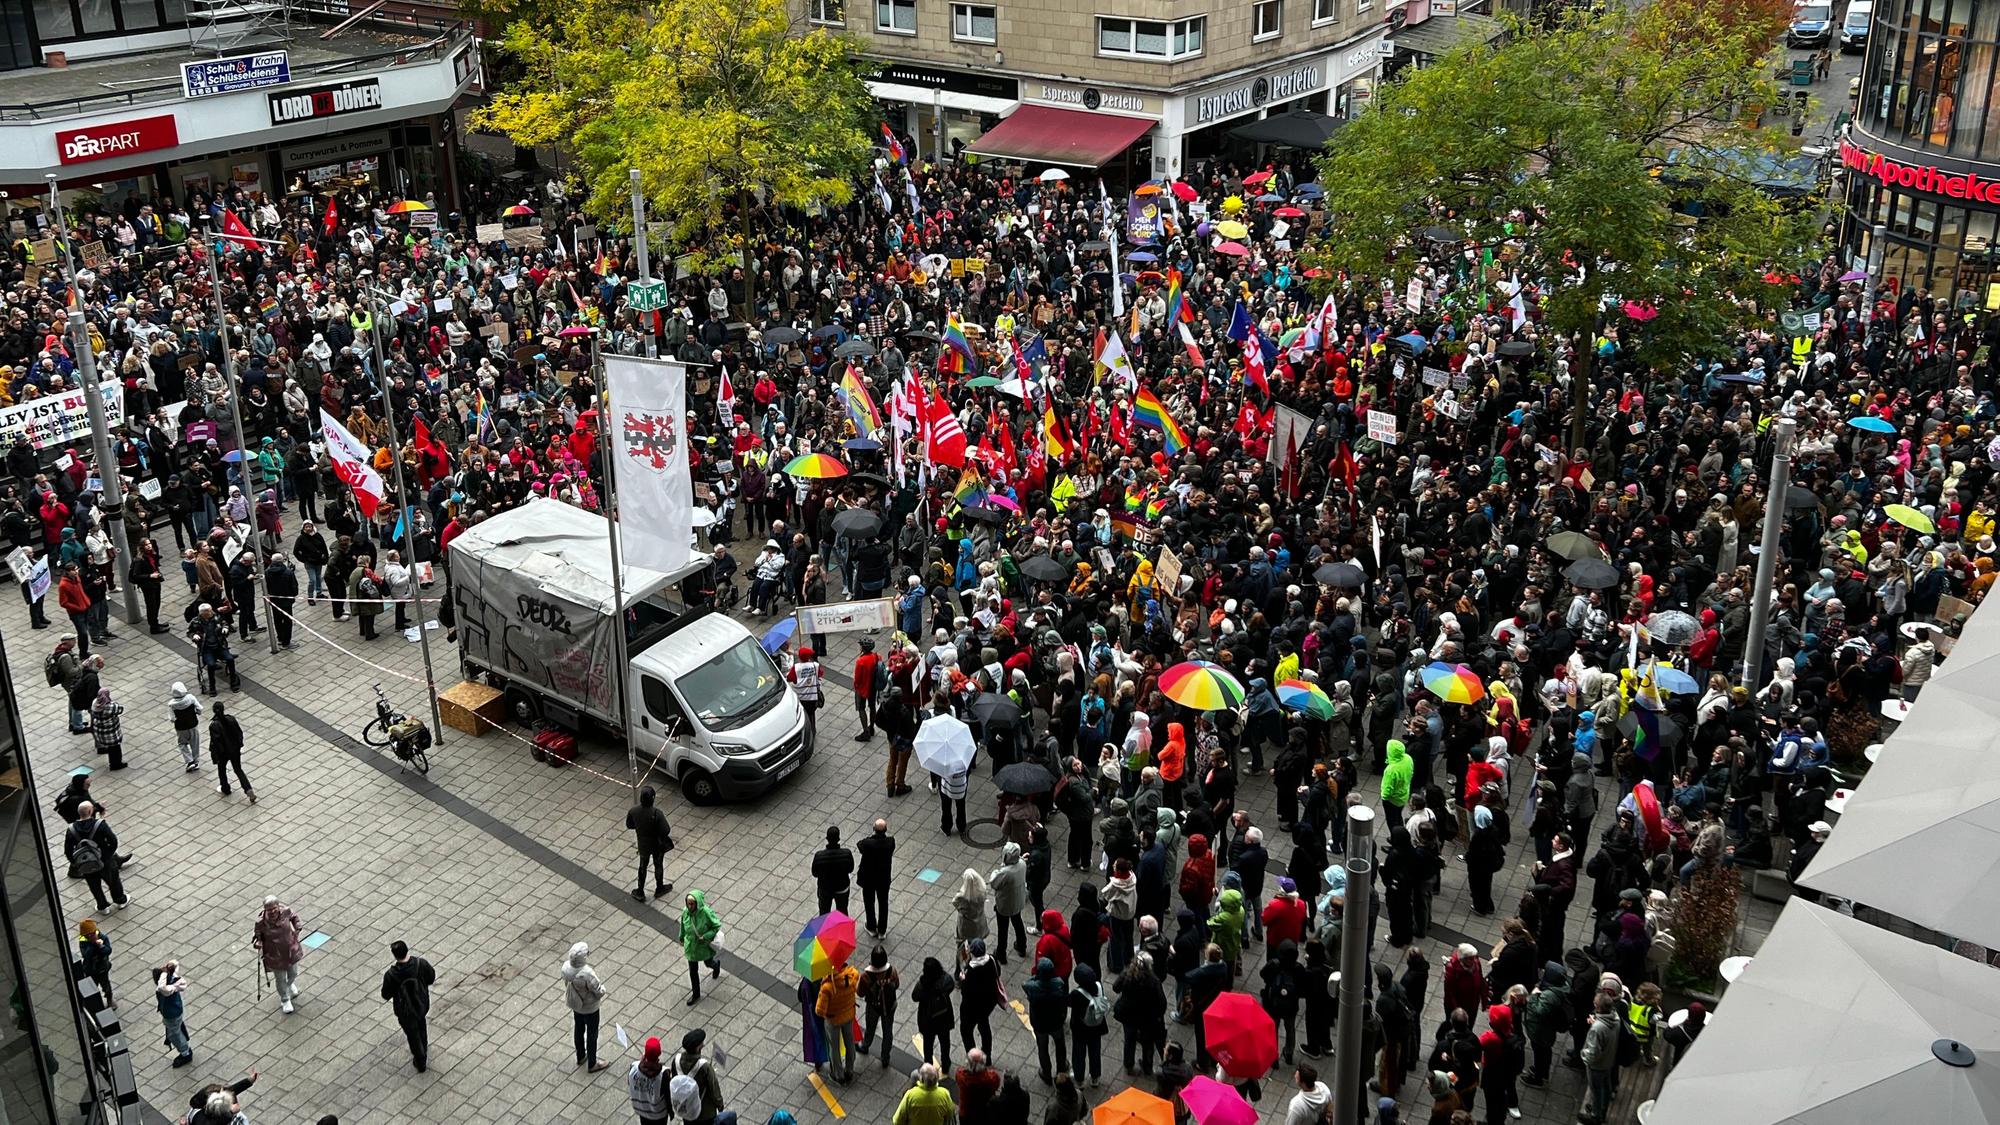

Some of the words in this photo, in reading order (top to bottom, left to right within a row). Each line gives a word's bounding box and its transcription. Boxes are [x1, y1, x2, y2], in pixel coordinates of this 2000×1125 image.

[206, 63, 236, 75] Schuh
[236, 61, 247, 73] &
[255, 55, 283, 67] Krahn
[208, 66, 280, 85] Schlüsseldienst
[223, 81, 250, 91] Gravuren
[256, 77, 280, 87] Stempel
[892, 71, 919, 80] BARBER
[923, 75, 946, 84] SALON
[273, 94, 313, 121] LORD
[317, 95, 330, 112] OF
[332, 83, 382, 110] DÖNER
[1042, 86, 1081, 104] Espresso
[1101, 93, 1143, 111] Perfetto
[1198, 87, 1251, 122] Espresso
[1271, 66, 1319, 100] Perfetto
[290, 143, 338, 162] Currywurst
[340, 142, 348, 152] &
[349, 136, 383, 150] Pommes
[1868, 153, 2000, 204] Apotheke
[1130, 223, 1156, 231] SCHEN
[32, 401, 60, 419] IST
[63, 386, 113, 410] BUT
[25, 422, 50, 435] eine
